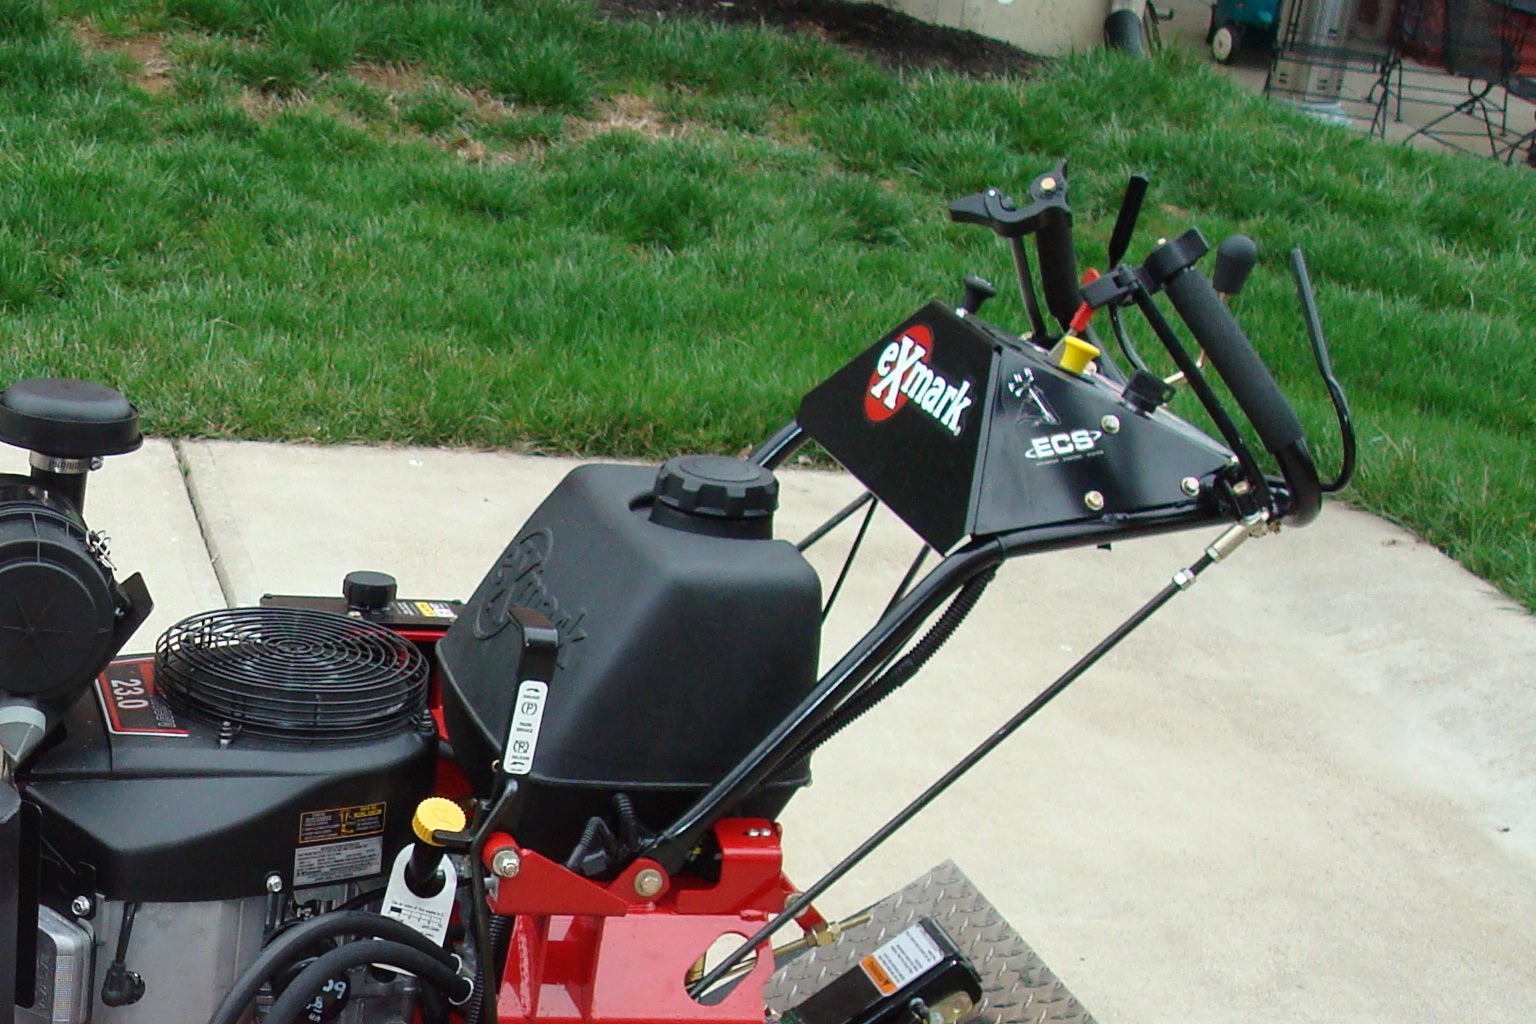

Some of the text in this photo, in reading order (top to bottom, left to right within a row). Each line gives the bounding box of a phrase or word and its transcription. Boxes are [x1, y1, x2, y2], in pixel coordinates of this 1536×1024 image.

[870, 334, 972, 436] eXmark
[1031, 428, 1096, 458] ECS
[110, 678, 149, 709] 23.0
